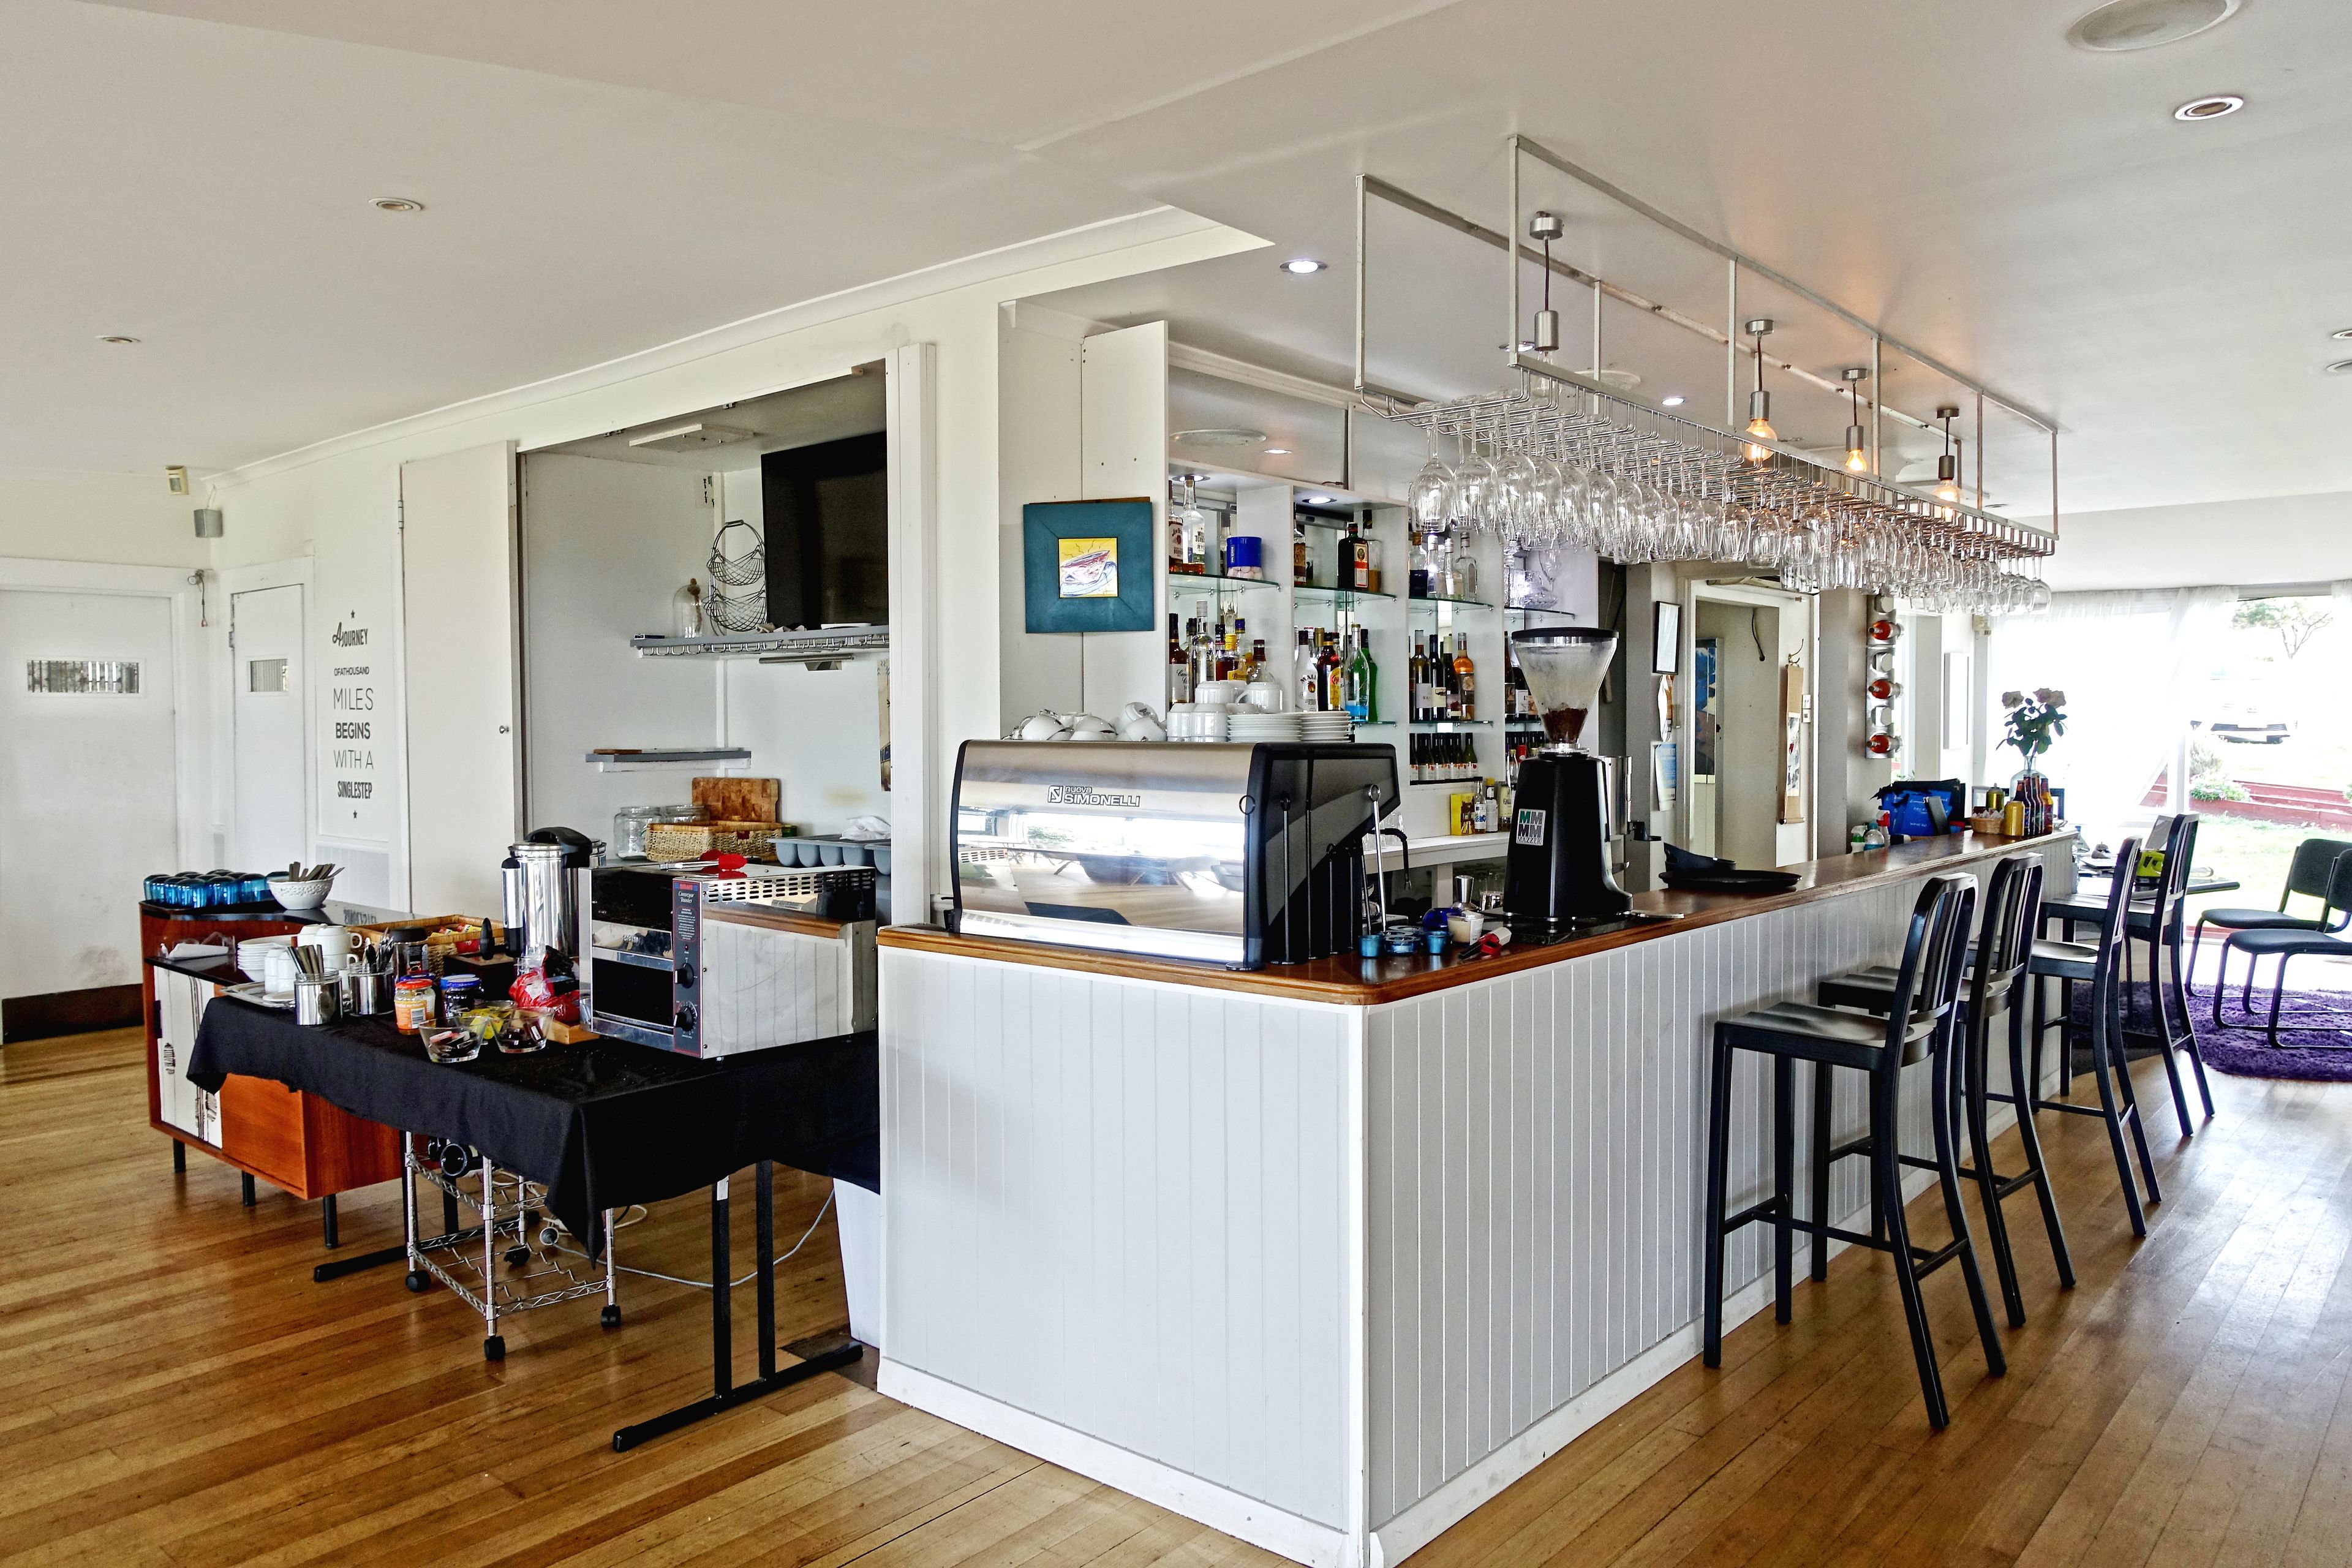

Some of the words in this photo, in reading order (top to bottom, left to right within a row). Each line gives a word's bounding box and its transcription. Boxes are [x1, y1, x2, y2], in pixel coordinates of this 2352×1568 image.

[333, 687, 374, 710] MILES
[335, 722, 371, 740] BEGINS
[333, 749, 361, 769] WITH
[365, 750, 374, 770] A
[1064, 793, 1140, 807] SIMONELLI
[1517, 836, 1542, 845] MAZZER
